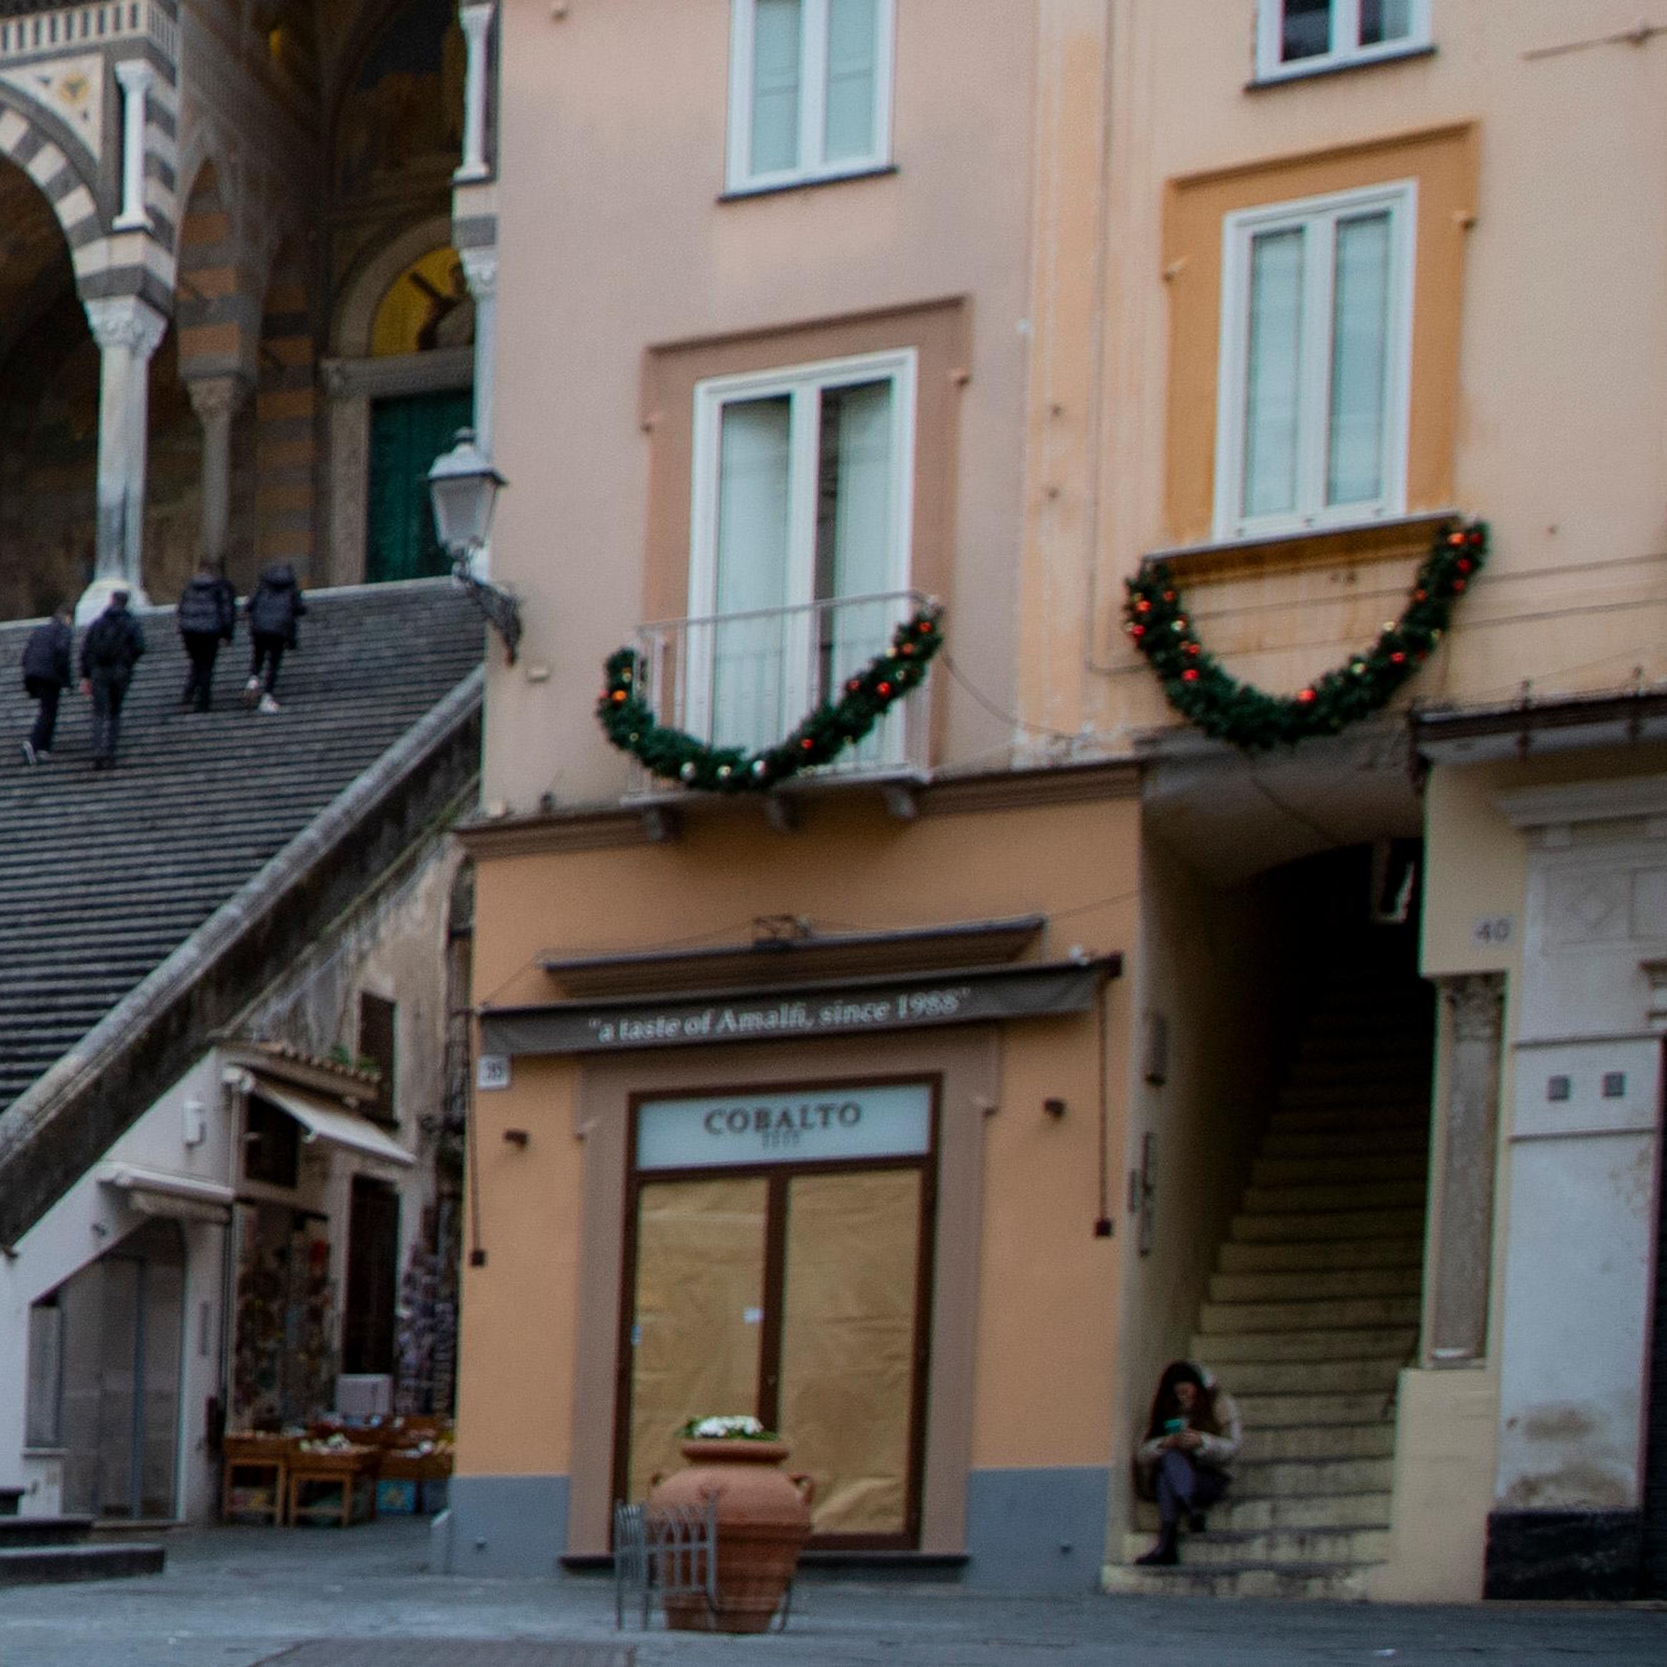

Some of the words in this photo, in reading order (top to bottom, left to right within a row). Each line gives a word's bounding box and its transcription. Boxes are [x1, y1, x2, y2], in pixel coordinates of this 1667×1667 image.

[618, 1015, 682, 1041] taste
[683, 1008, 715, 1035] of
[715, 1002, 815, 1033] Amalfi,
[818, 999, 892, 1027] since
[703, 1101, 863, 1135] COBALTO
